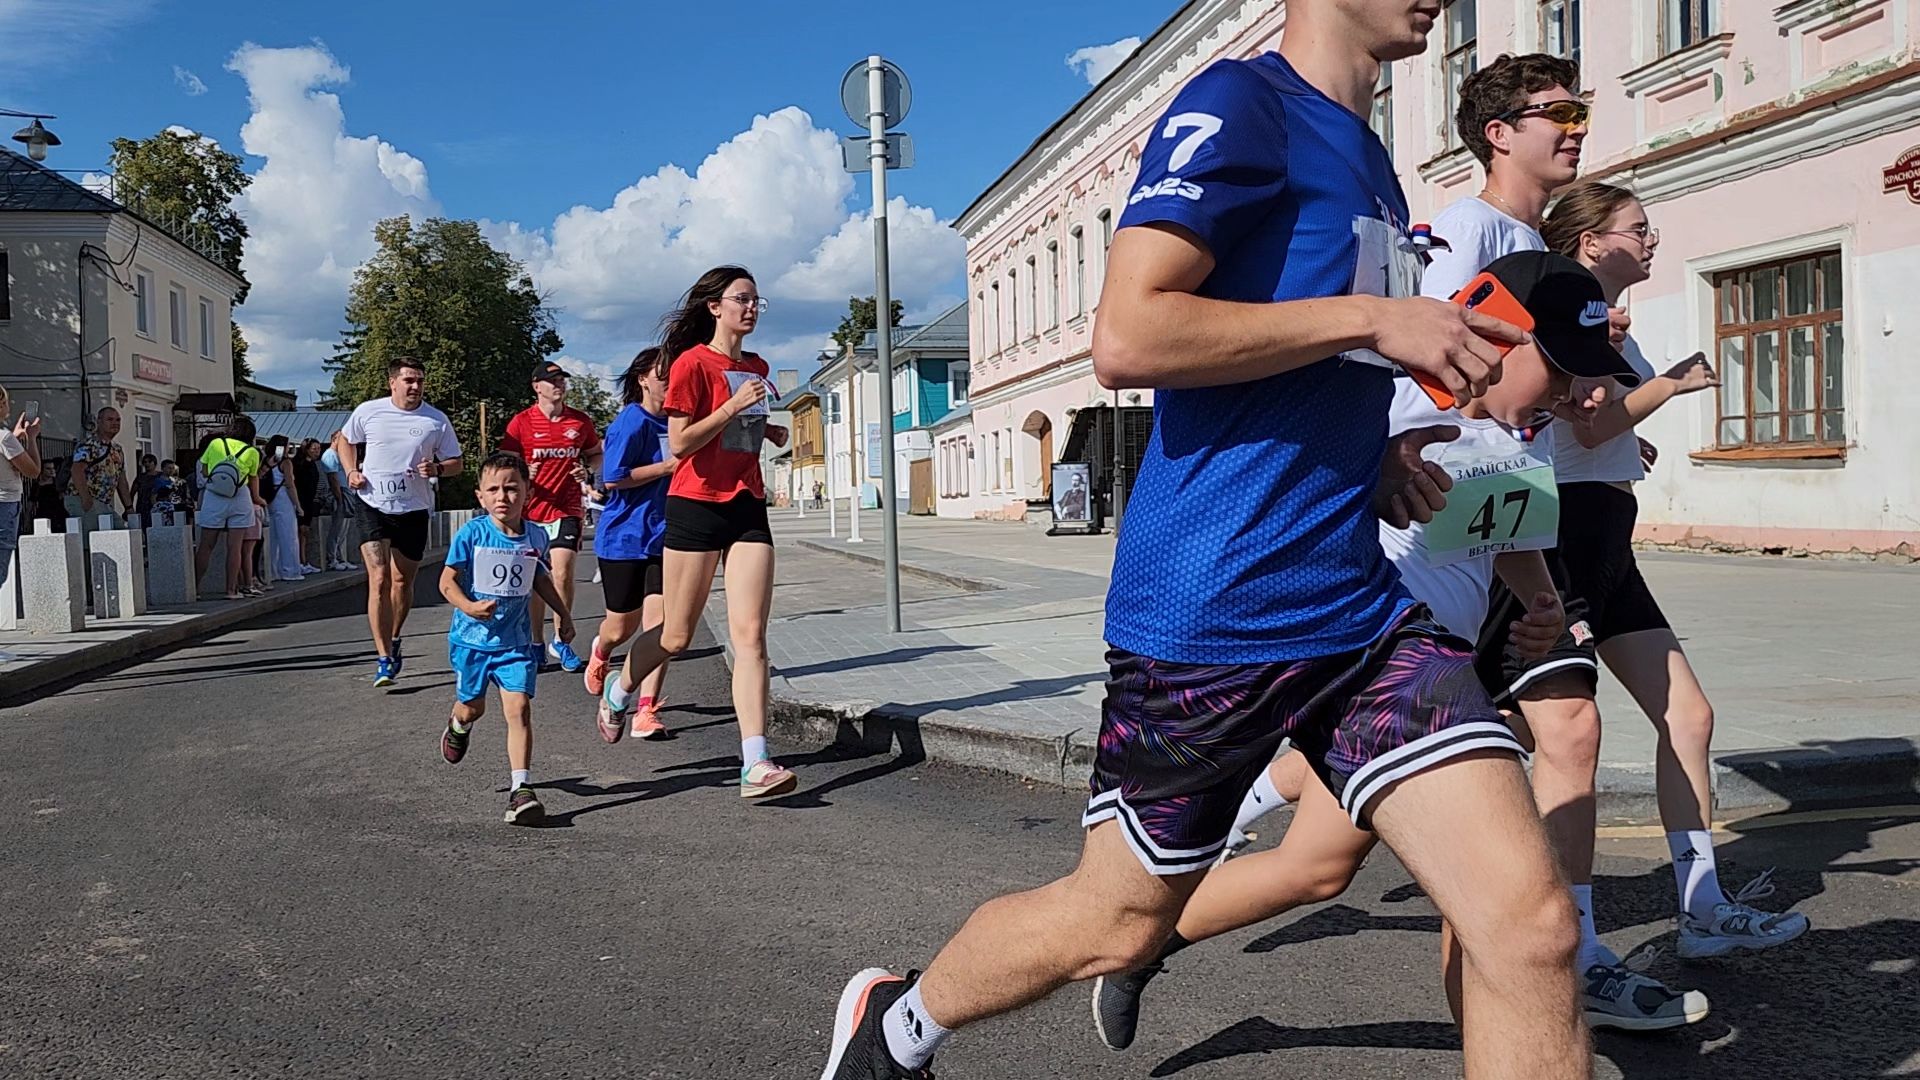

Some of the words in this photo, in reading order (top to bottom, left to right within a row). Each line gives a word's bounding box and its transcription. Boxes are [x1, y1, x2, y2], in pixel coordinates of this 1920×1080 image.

[1163, 112, 1223, 173] 7
[1129, 178, 1204, 205] 2023
[1455, 457, 1528, 480] ЗАРАЙСКАЯ
[379, 478, 408, 495] 104
[1467, 488, 1532, 541] 47
[1468, 542, 1516, 558] ВЕРСТА
[492, 563, 523, 588] 98
